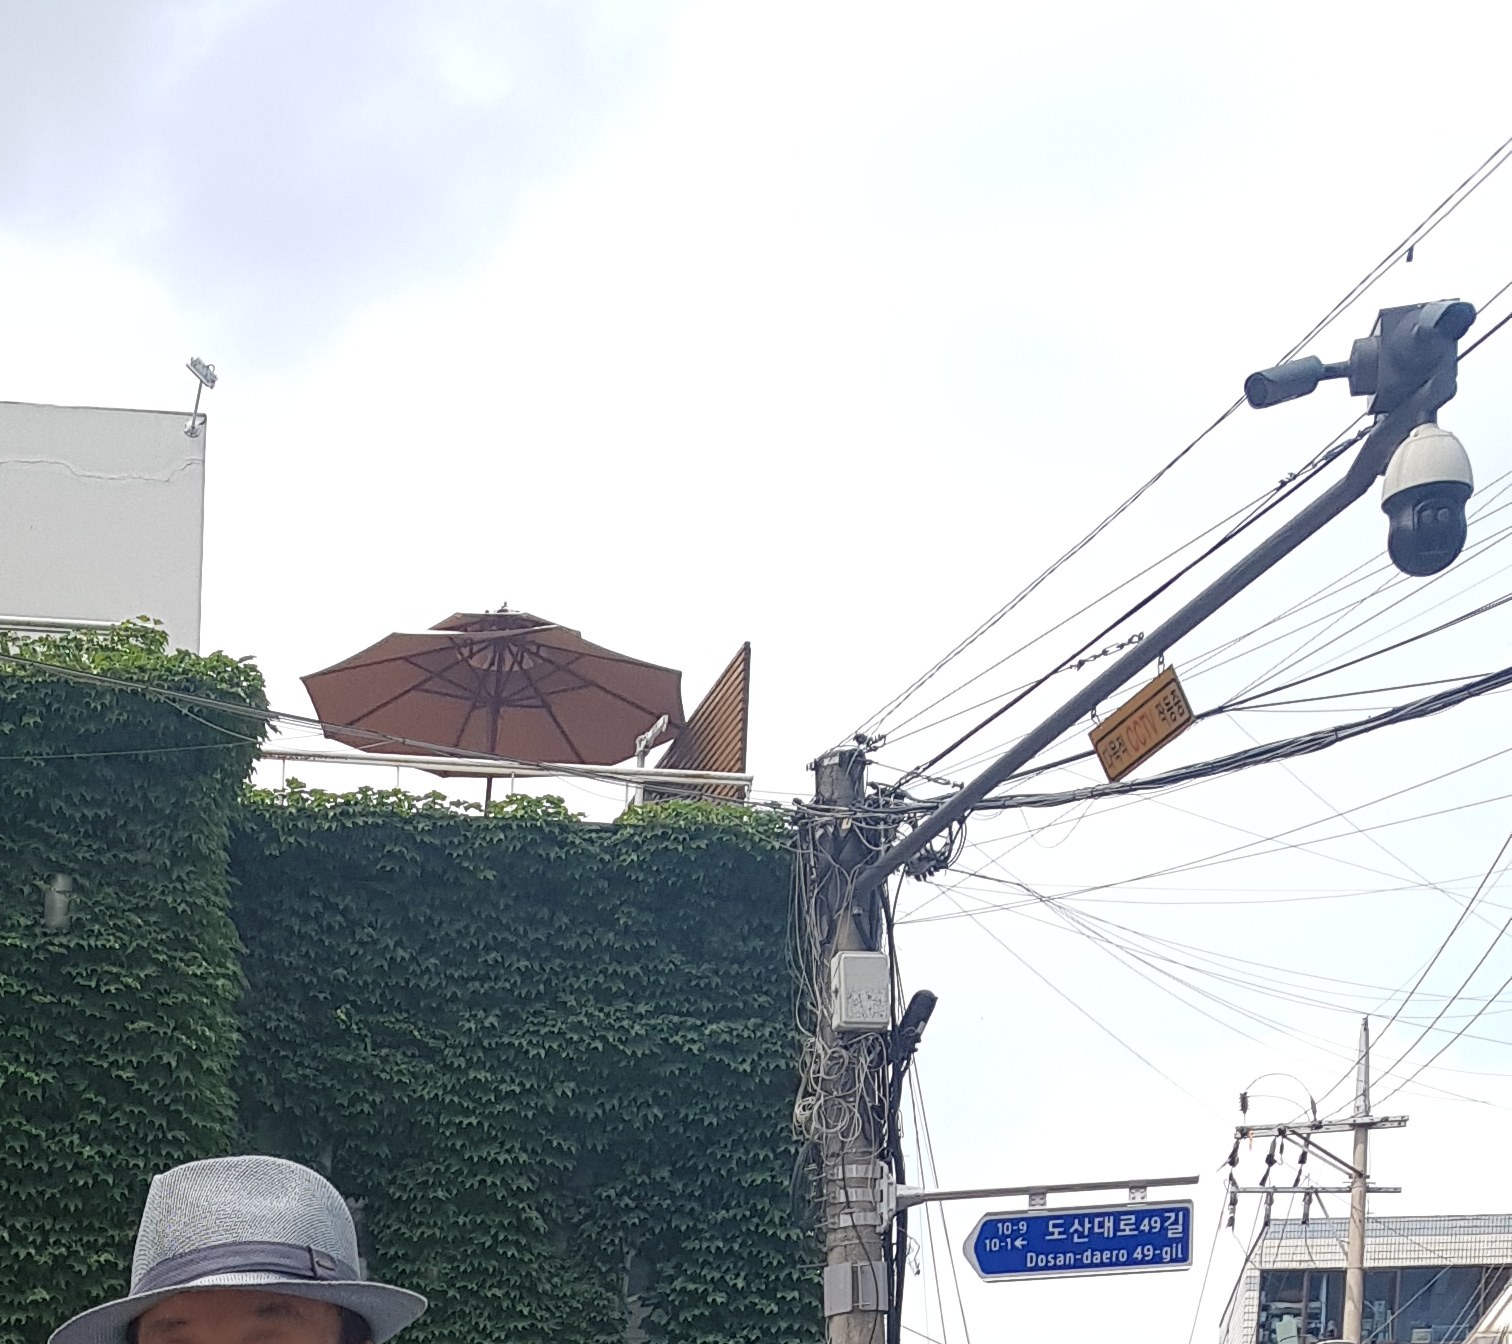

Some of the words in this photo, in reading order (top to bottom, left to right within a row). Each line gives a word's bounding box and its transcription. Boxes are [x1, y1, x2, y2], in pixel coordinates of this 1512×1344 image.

[1125, 711, 1158, 752] CCTV
[997, 1221, 1027, 1235] 10-9
[1045, 1211, 1183, 1243] 도산대로49길
[985, 1238, 1012, 1251] 10-1
[1026, 1248, 1127, 1268] Dosan-daero
[1133, 1244, 1183, 1264] 49-gil
